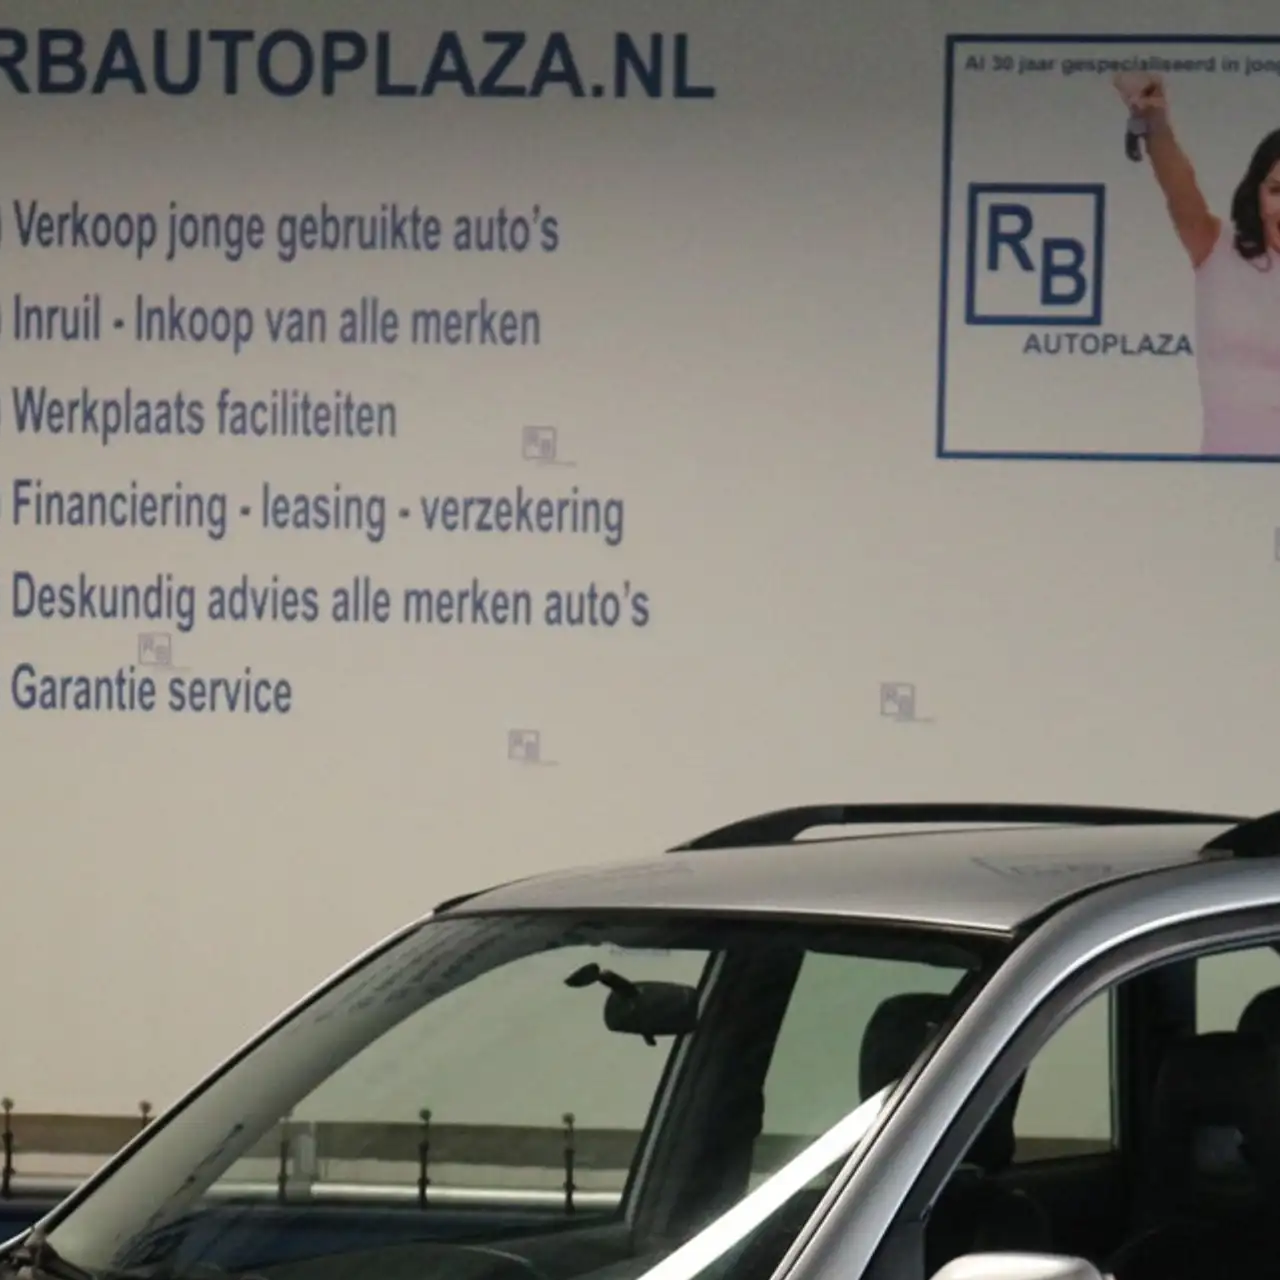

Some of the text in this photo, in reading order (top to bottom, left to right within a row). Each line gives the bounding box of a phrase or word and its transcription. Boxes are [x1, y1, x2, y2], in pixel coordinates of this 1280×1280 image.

[1018, 56, 1056, 75] jaar
[1221, 57, 1240, 72] in
[12, 199, 158, 259] Verkoop
[166, 202, 266, 262] jonge
[277, 203, 442, 262] gebruikte
[453, 206, 560, 252] auto's
[13, 294, 101, 342] Inruil
[135, 296, 254, 354] Inkoop
[265, 307, 327, 344] van
[339, 299, 400, 344] alle
[411, 300, 541, 346] merken
[1023, 332, 1194, 357] AUTOPLAZA
[11, 387, 205, 446] Werkplaats
[216, 389, 397, 438] faciliteiten
[13, 479, 227, 541] Financiering
[262, 483, 386, 543] leasing
[420, 487, 624, 546] verzekering
[12, 571, 195, 633] Deskundig
[207, 574, 319, 623] advies
[331, 576, 391, 624] alle
[403, 579, 533, 626] merken
[544, 580, 650, 627] auto's
[11, 663, 157, 712] Garantie
[168, 666, 292, 714] service
